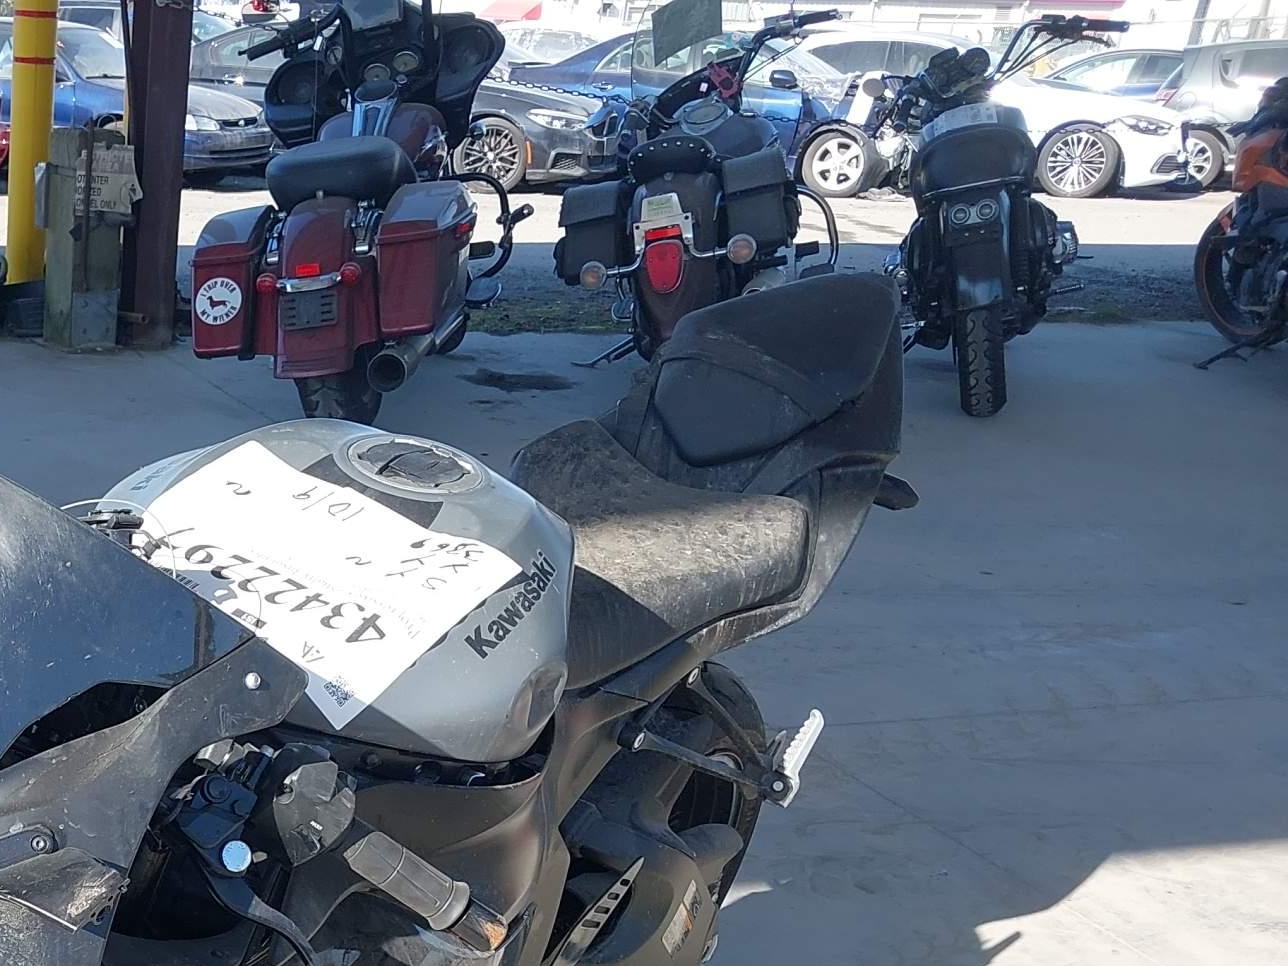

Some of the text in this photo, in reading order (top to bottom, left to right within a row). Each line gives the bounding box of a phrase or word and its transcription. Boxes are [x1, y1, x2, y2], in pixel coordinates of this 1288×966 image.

[203, 280, 218, 293] TRIP
[220, 280, 237, 294] OVER
[200, 308, 211, 321] MY
[463, 550, 557, 660] Kawasaki
